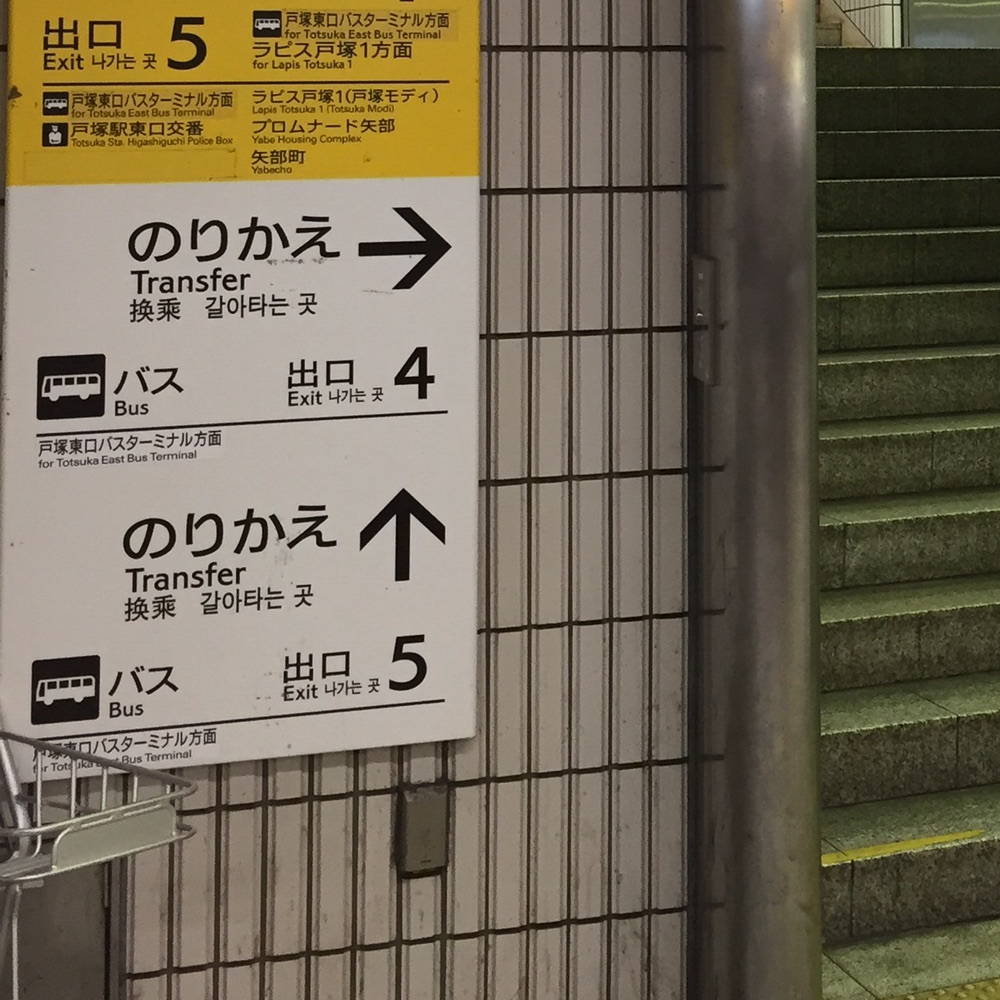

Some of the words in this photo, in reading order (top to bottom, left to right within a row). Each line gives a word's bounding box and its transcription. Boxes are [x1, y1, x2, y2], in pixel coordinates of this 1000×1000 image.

[285, 12, 449, 28] 戸塚東口バスターミナル方面
[43, 17, 122, 50] 出口
[167, 17, 208, 70] 5
[285, 29, 300, 39] for
[304, 30, 346, 40] Totsuka
[348, 30, 371, 40] East
[374, 30, 394, 39] Bus
[397, 30, 441, 40] Terminal
[252, 41, 413, 59] ラピス戸塚1方面
[43, 53, 84, 71] Exit
[91, 54, 137, 70] 나가는
[143, 53, 157, 71] 곳
[252, 60, 269, 70] for
[272, 60, 301, 71] Lapis
[304, 60, 345, 69] Totsuka
[348, 60, 353, 69] 1
[71, 91, 233, 109] 戸塚東口バスターミナル方面
[252, 105, 277, 115] Lapis
[281, 105, 316, 113] Totsuka
[319, 105, 324, 113] 1
[327, 105, 365, 114] (Totsuka
[368, 104, 394, 113] Modi)
[71, 108, 85, 118] for
[87, 109, 127, 118] Totsuka
[128, 108, 149, 117] East
[152, 108, 170, 117] Bus
[173, 107, 215, 117] Terminal
[70, 121, 203, 137] 戸塚駅東口交番
[252, 118, 395, 134] プロムナード矢部
[72, 138, 106, 147] Totsuka
[108, 138, 124, 147] Sta.
[128, 137, 185, 148] Higashiguchi
[187, 136, 213, 145] Police
[216, 136, 233, 145] Box
[252, 135, 275, 144] Yabe
[278, 135, 317, 145] Housing
[320, 135, 362, 145] Complex
[251, 150, 306, 165] 矢部町
[252, 165, 293, 174] Yabecho
[128, 215, 340, 262] のりかえ
[131, 268, 251, 295] Transfer
[205, 293, 290, 320] 갈아타는
[298, 292, 318, 317] 곳
[113, 367, 184, 396] バス
[288, 359, 354, 389] 出口
[394, 347, 435, 400] 4
[288, 391, 322, 407] Exit
[328, 388, 367, 404] 나가는
[372, 387, 384, 402] 곳
[115, 400, 149, 417] Bus
[38, 430, 222, 457] 戸塚東口バスターミナル方面
[38, 459, 54, 469] for
[56, 456, 99, 467] Totsuka
[101, 454, 125, 465] East
[127, 453, 148, 463] Bus
[150, 450, 197, 461] Terminal
[122, 505, 337, 559] のりかえ
[125, 563, 247, 593] Transfer
[200, 587, 286, 616] 갈아타는
[294, 584, 314, 609] 곳
[283, 651, 351, 683] 出口
[388, 634, 427, 691] 5
[108, 665, 179, 697] バス
[283, 685, 319, 702] Exit
[324, 681, 363, 697] 나가는
[367, 678, 381, 694] 곳
[109, 702, 144, 719] Bus
[33, 728, 217, 761] 口バスターミナル方面
[33, 764, 48, 774] fr
[122, 755, 143, 765] Bus
[147, 750, 192, 763] Terminal
